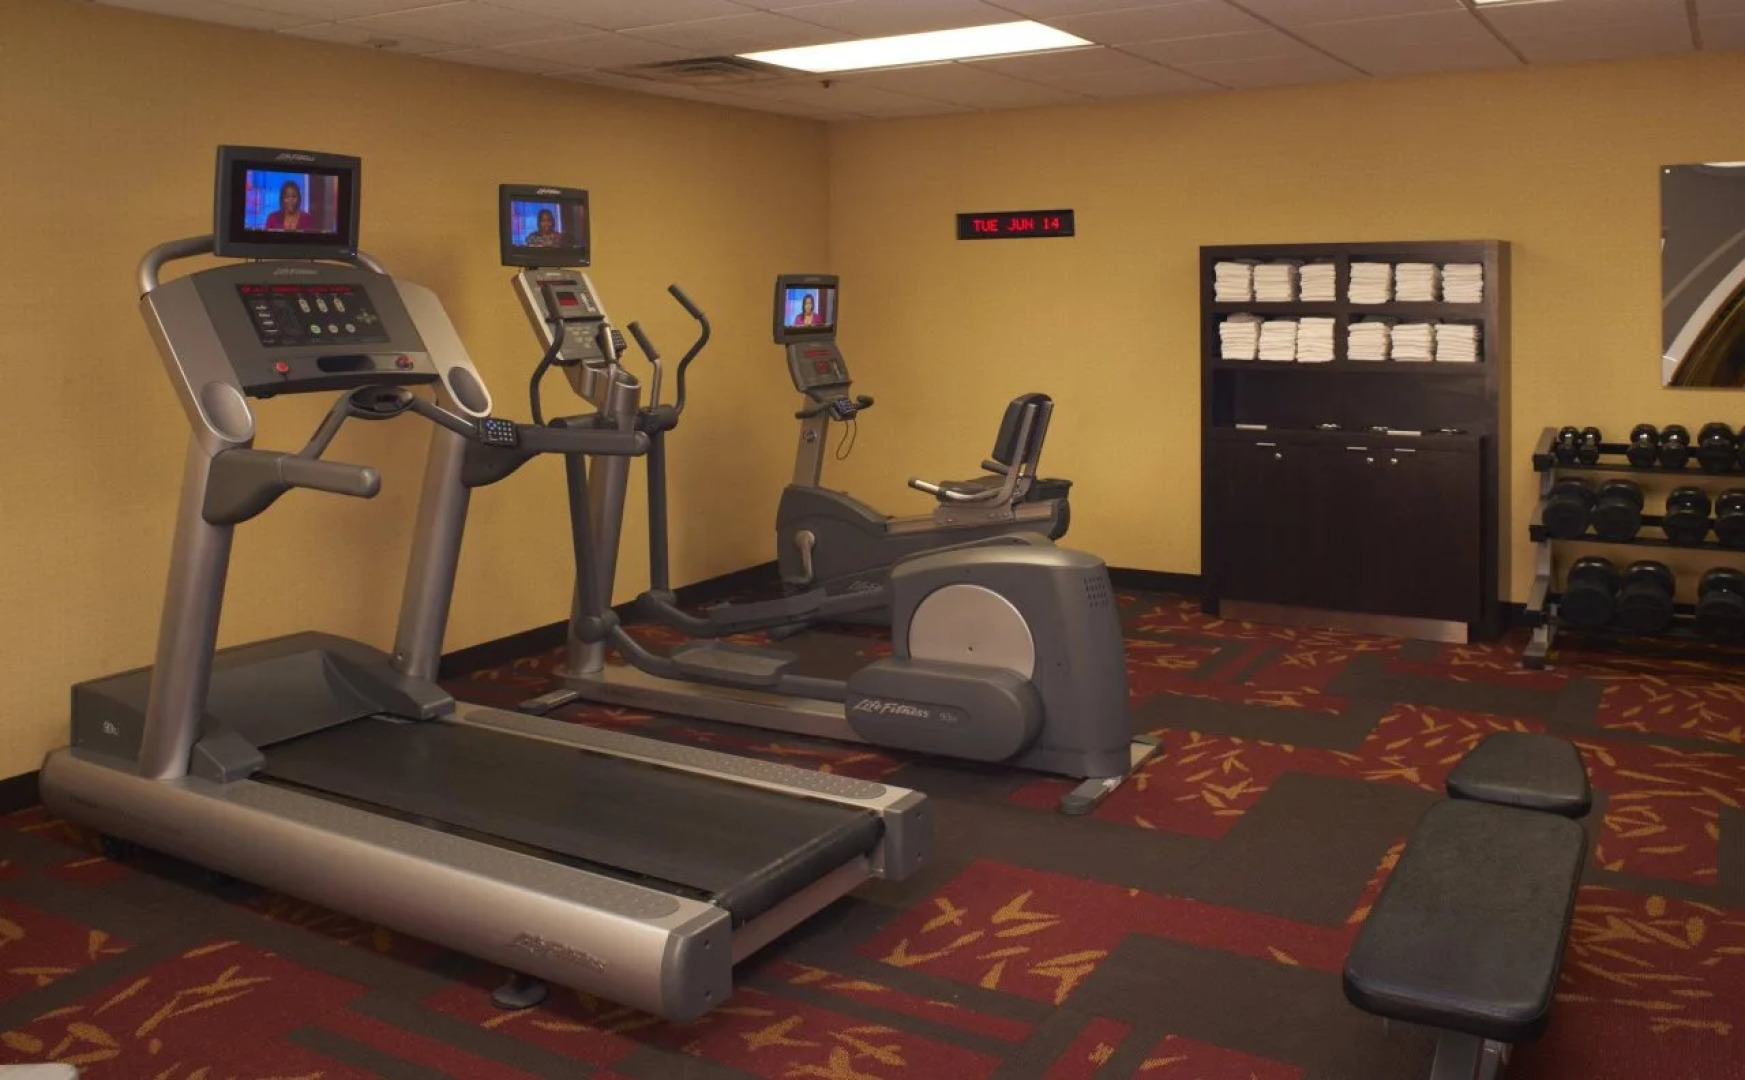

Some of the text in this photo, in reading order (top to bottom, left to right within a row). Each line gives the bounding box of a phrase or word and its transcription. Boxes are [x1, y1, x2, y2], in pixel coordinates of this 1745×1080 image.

[973, 217, 1060, 232] TUE JUN 14
